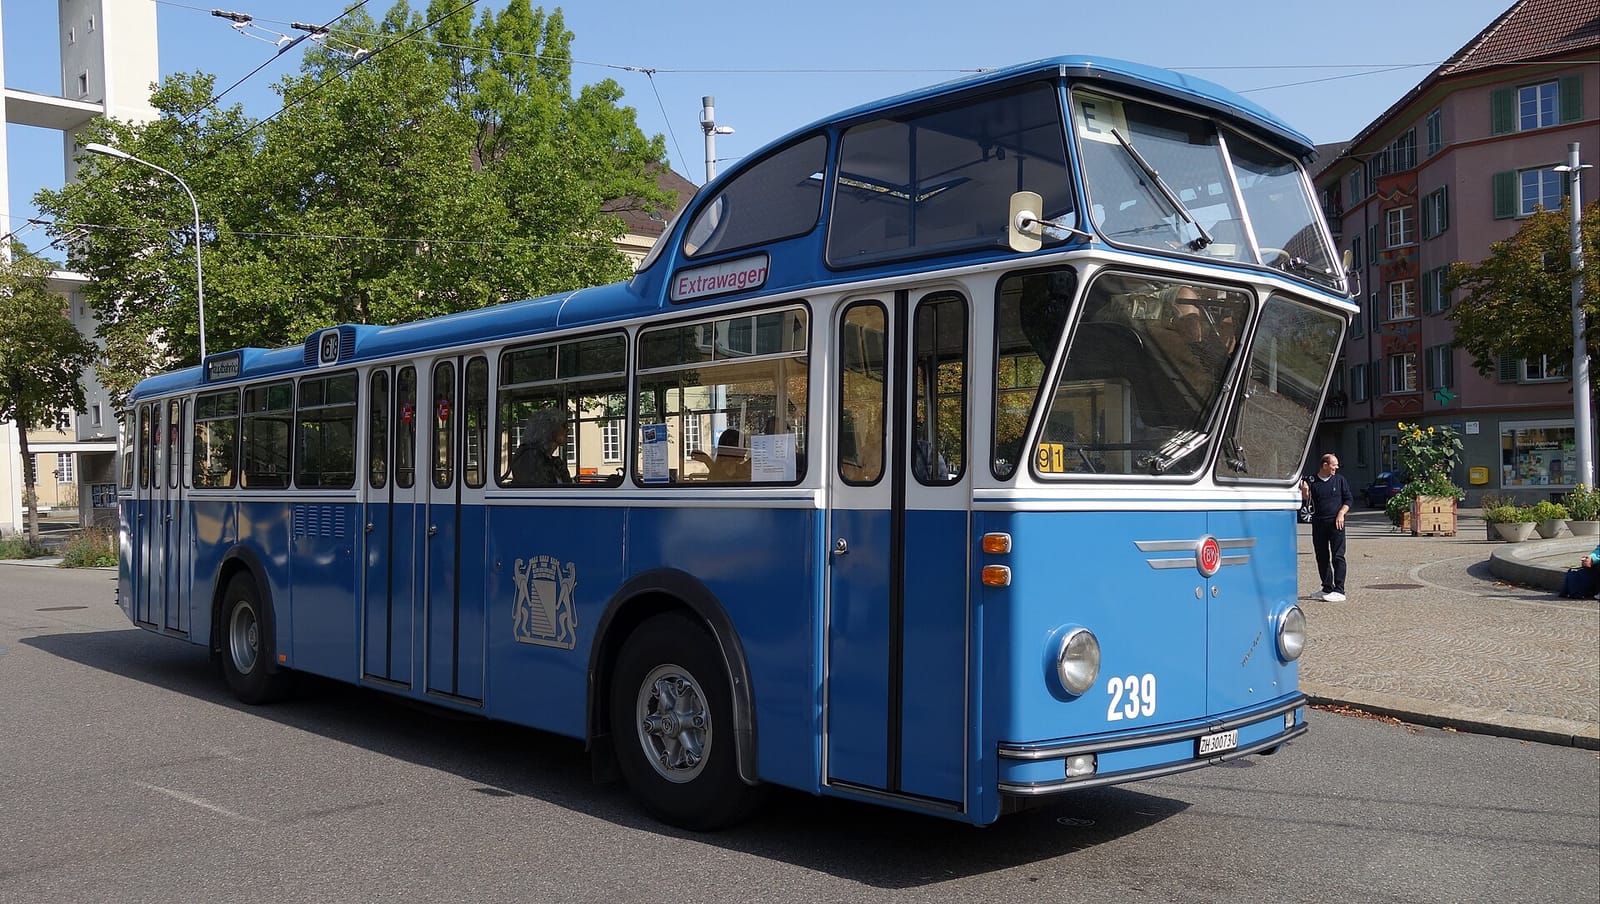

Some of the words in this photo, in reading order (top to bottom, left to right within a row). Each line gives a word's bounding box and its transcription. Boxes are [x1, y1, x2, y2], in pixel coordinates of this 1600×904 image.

[1081, 101, 1102, 134] E
[678, 266, 767, 296] Extrawagen
[1107, 673, 1156, 721] 239
